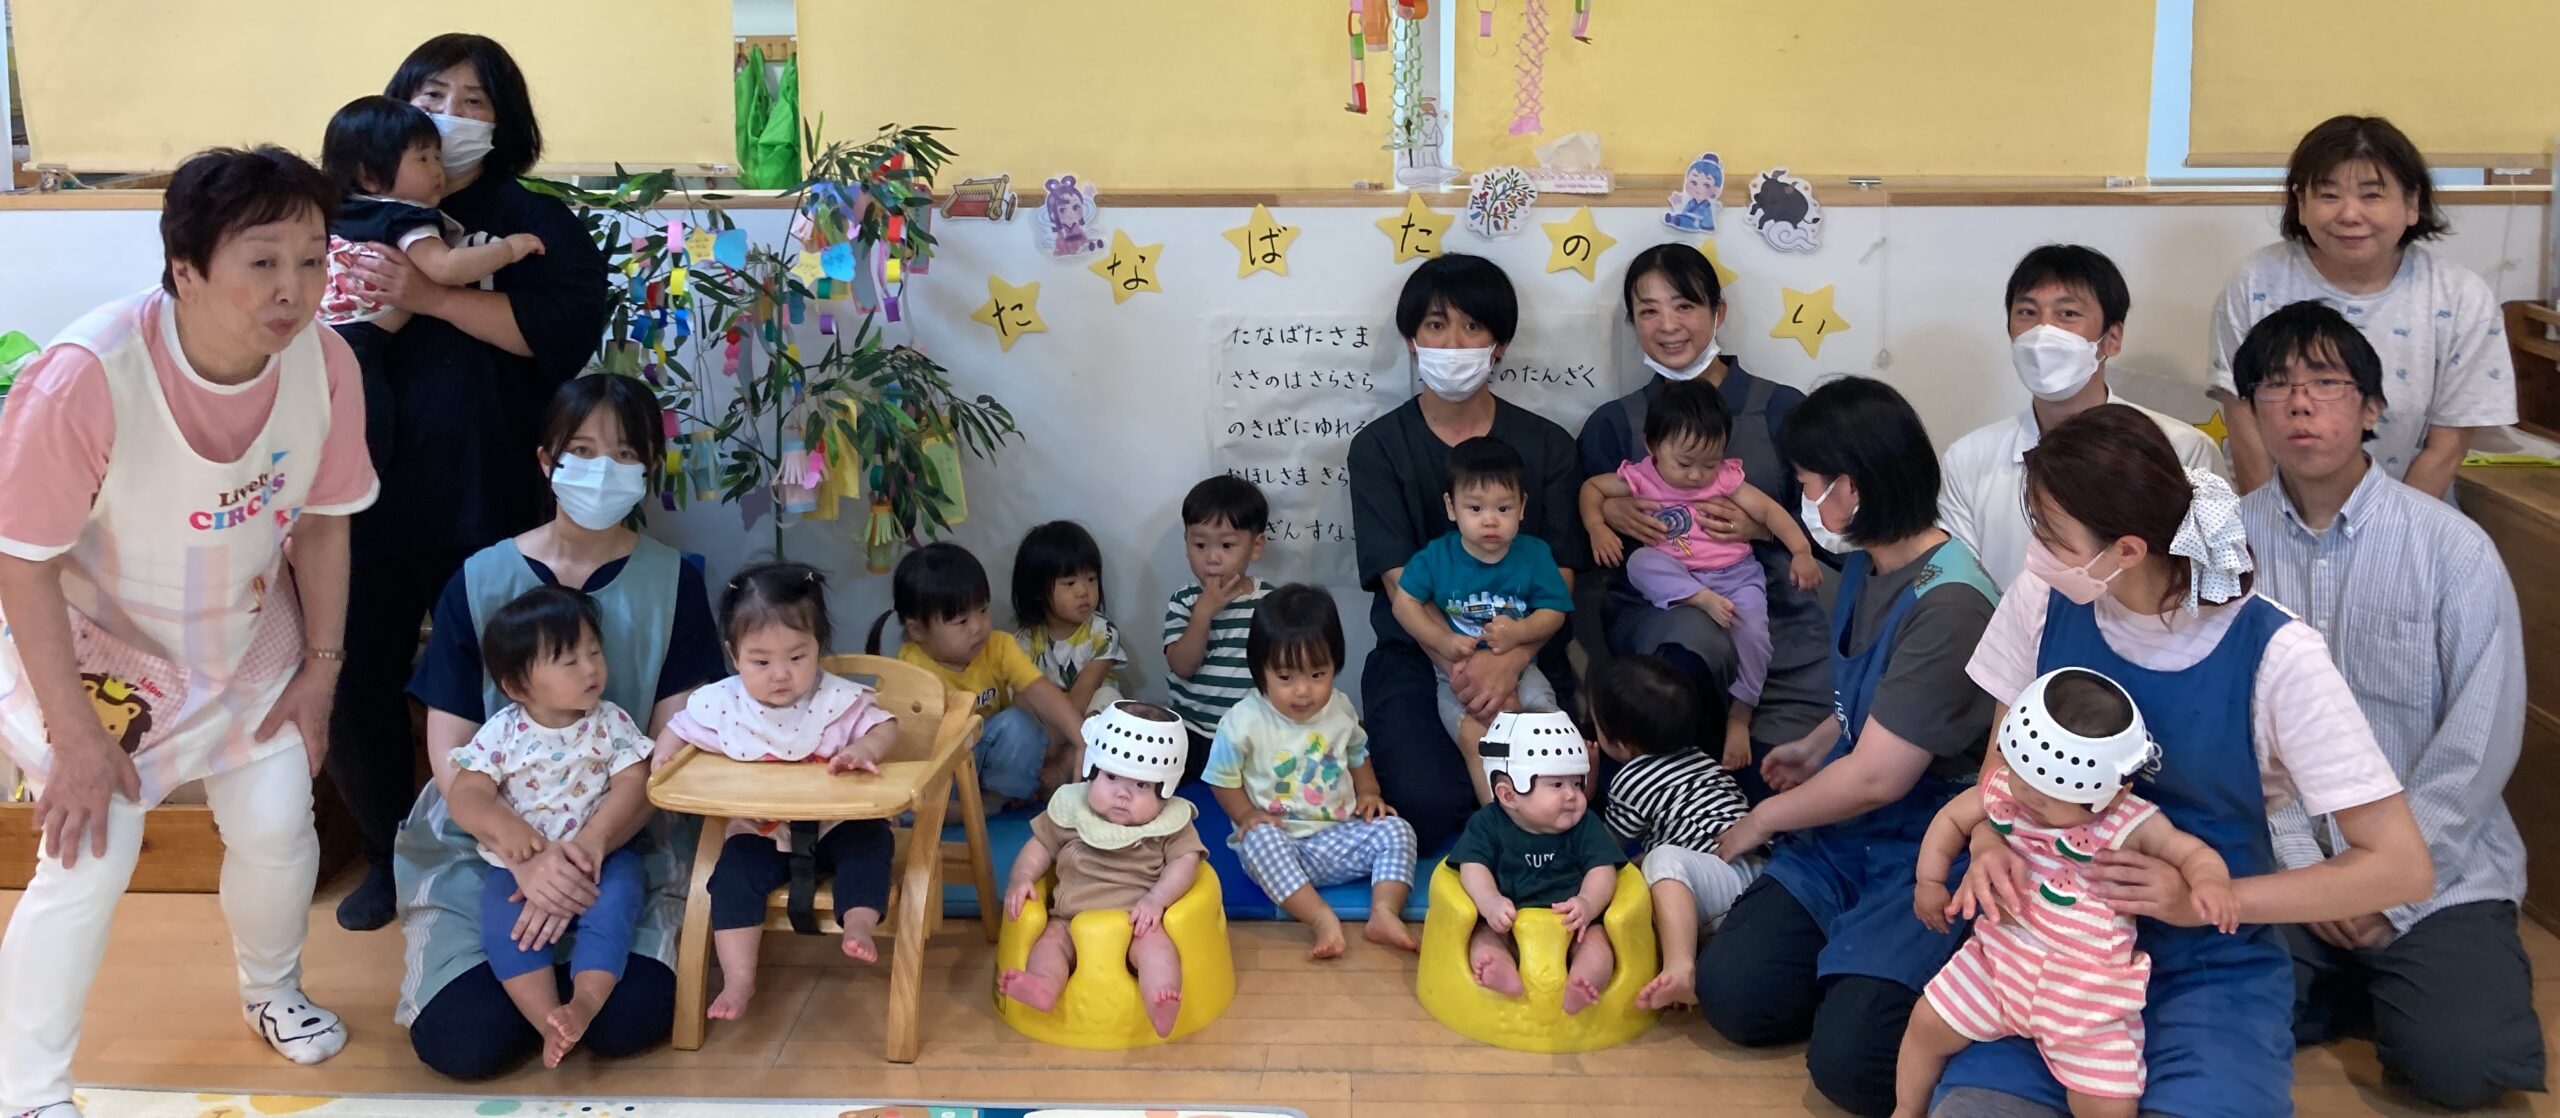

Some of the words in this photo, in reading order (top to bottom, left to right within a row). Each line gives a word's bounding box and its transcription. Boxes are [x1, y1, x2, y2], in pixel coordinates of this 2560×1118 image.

[1231, 323, 1369, 349] たなばたさま
[1486, 364, 1596, 388] のたんざく
[188, 471, 285, 531] CIRCUS
